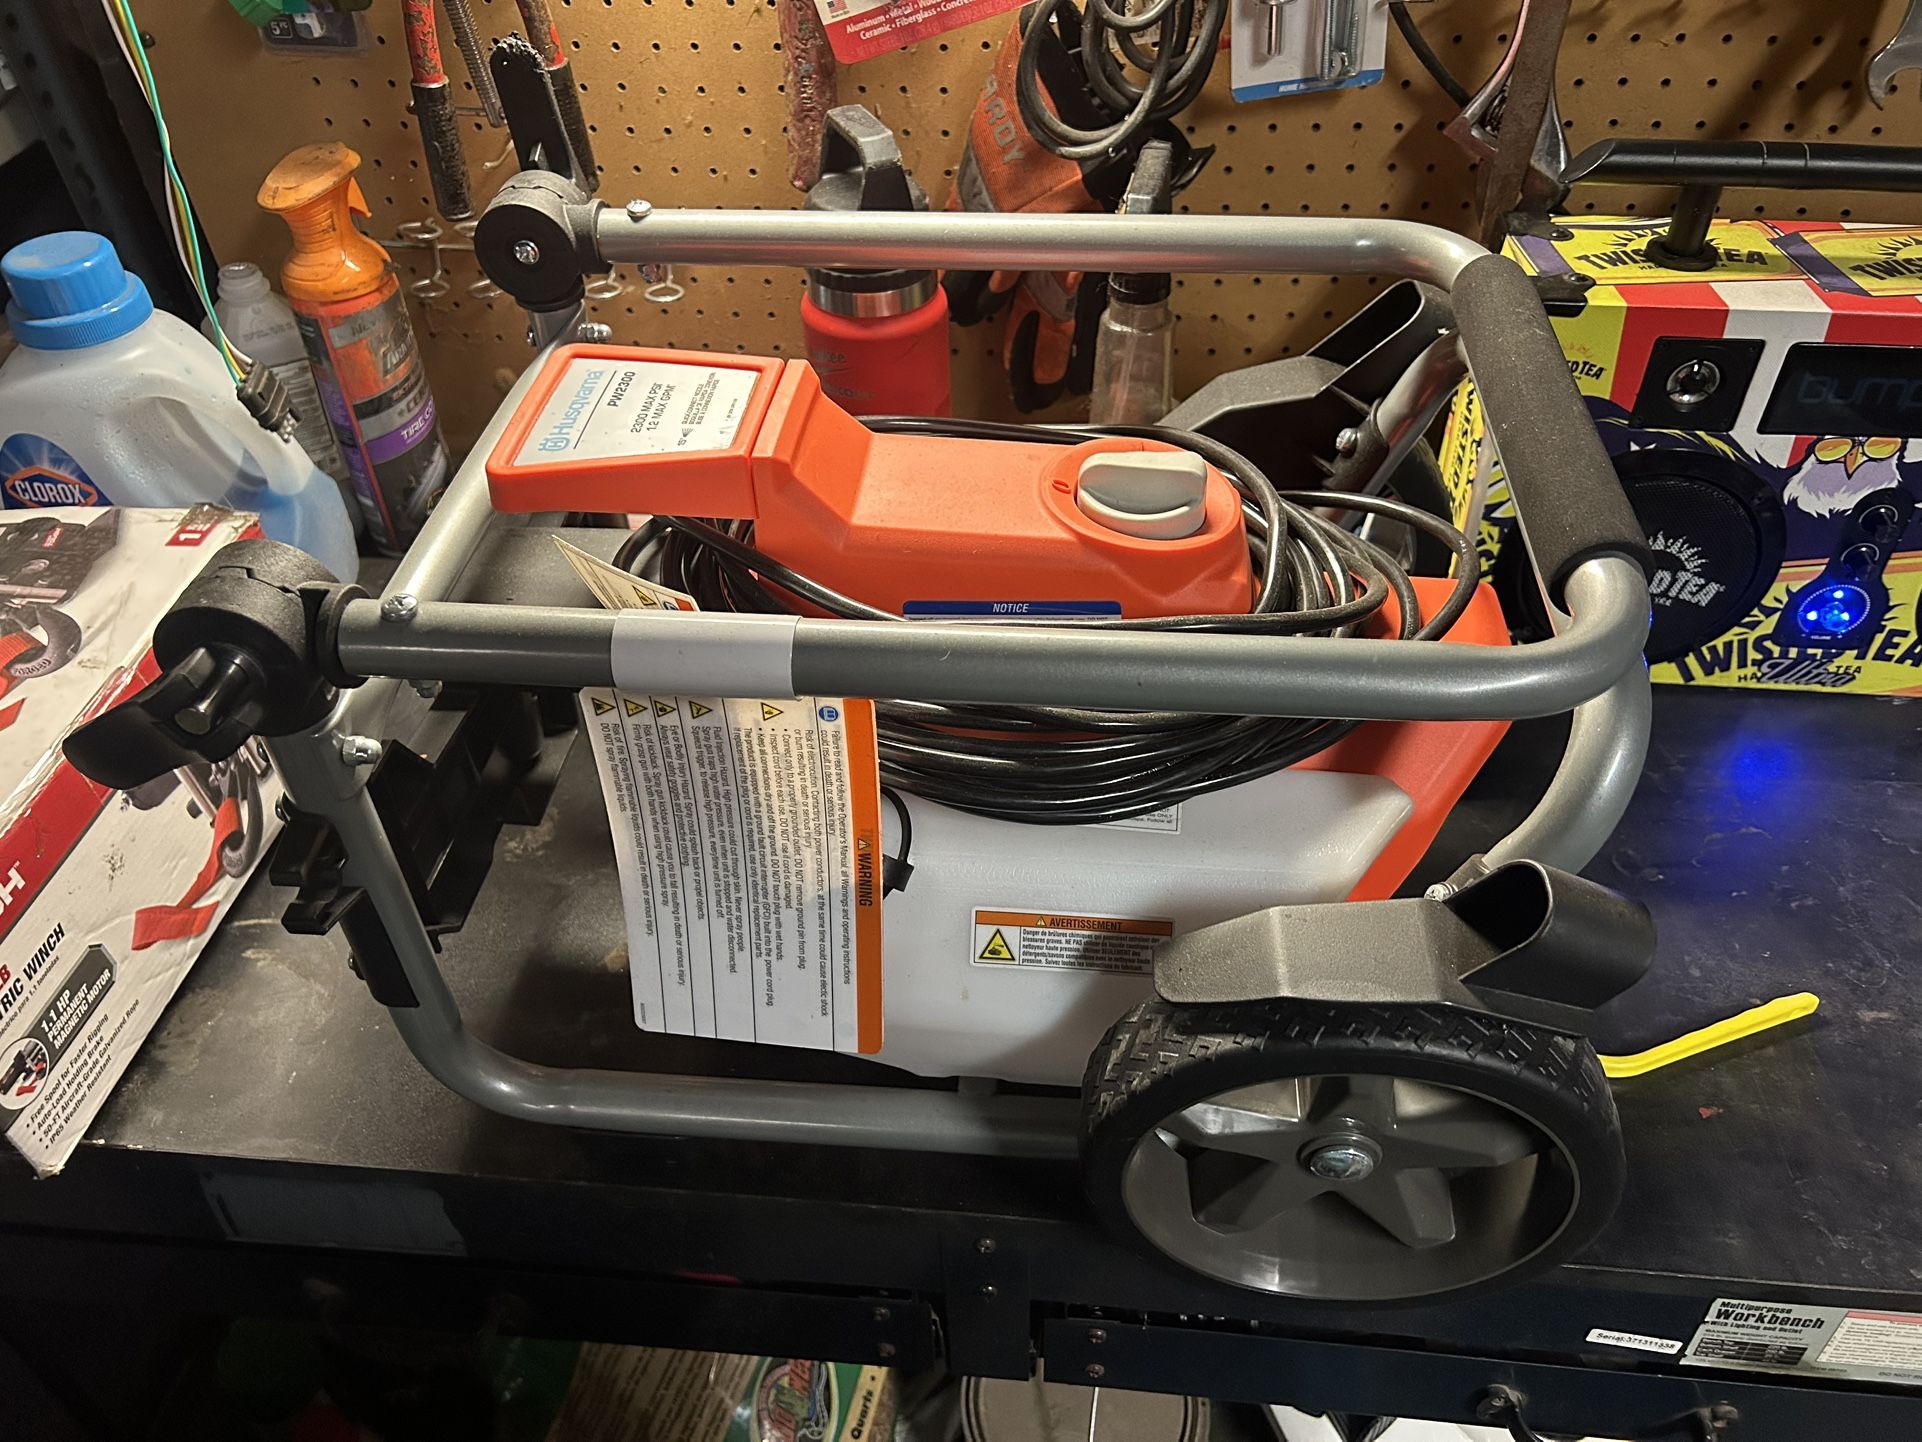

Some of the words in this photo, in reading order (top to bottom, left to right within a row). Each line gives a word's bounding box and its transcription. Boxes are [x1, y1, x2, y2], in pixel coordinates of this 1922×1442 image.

[846, 14, 887, 34] Aluminum
[859, 23, 892, 40] Ceramic
[896, 7, 938, 28] Fiberglass
[607, 371, 637, 407] PW2300
[1580, 361, 1605, 381] TEA
[549, 369, 605, 436] Husqvarna
[630, 413, 648, 433] 2300
[640, 395, 657, 413] MAX
[652, 402, 668, 420] MAX
[14, 479, 86, 504] CLOROX
[1667, 570, 1722, 607] TEA
[992, 602, 1030, 614] NOTICE
[1759, 658, 1857, 687] Ultra
[1835, 665, 1862, 674] TEA
[856, 852, 872, 907] WARNING
[1022, 928, 1040, 937] Danger
[1068, 932, 1093, 940] chimiques
[1049, 916, 1122, 931] AVERTISSEMENT
[22, 922, 65, 982] WINCH
[17, 996, 30, 1014] para
[29, 984, 38, 997] 1.1
[37, 955, 60, 986] toneladas
[41, 1009, 58, 1033] 1.1
[56, 989, 71, 1013] HP
[47, 984, 90, 1042] PERMANENT
[53, 1003, 88, 1050] MAGNETIC
[86, 968, 112, 1004] MOTOR
[30, 1104, 45, 1124] Free
[44, 1078, 62, 1104] Spool
[60, 1068, 70, 1080] for
[70, 1042, 88, 1068] Faster
[88, 1013, 109, 1044] Rigging
[37, 1088, 67, 1131] Auto-Load
[66, 1058, 89, 1090] Holding
[87, 1035, 104, 1060] Brake
[43, 1113, 62, 1138] 50-FT
[61, 1057, 101, 1116] Aircraft-Grade
[99, 1018, 128, 1059] Galvanized
[125, 999, 140, 1020] Rope
[49, 1124, 64, 1144] IP65
[63, 1093, 88, 1127] Weather
[86, 1054, 112, 1093] Resistant
[1715, 1308, 1825, 1329] Workbench
[1719, 1301, 1793, 1314] Multipurpose
[1730, 1321, 1760, 1331] Lighting
[1778, 1325, 1803, 1334] Outlet
